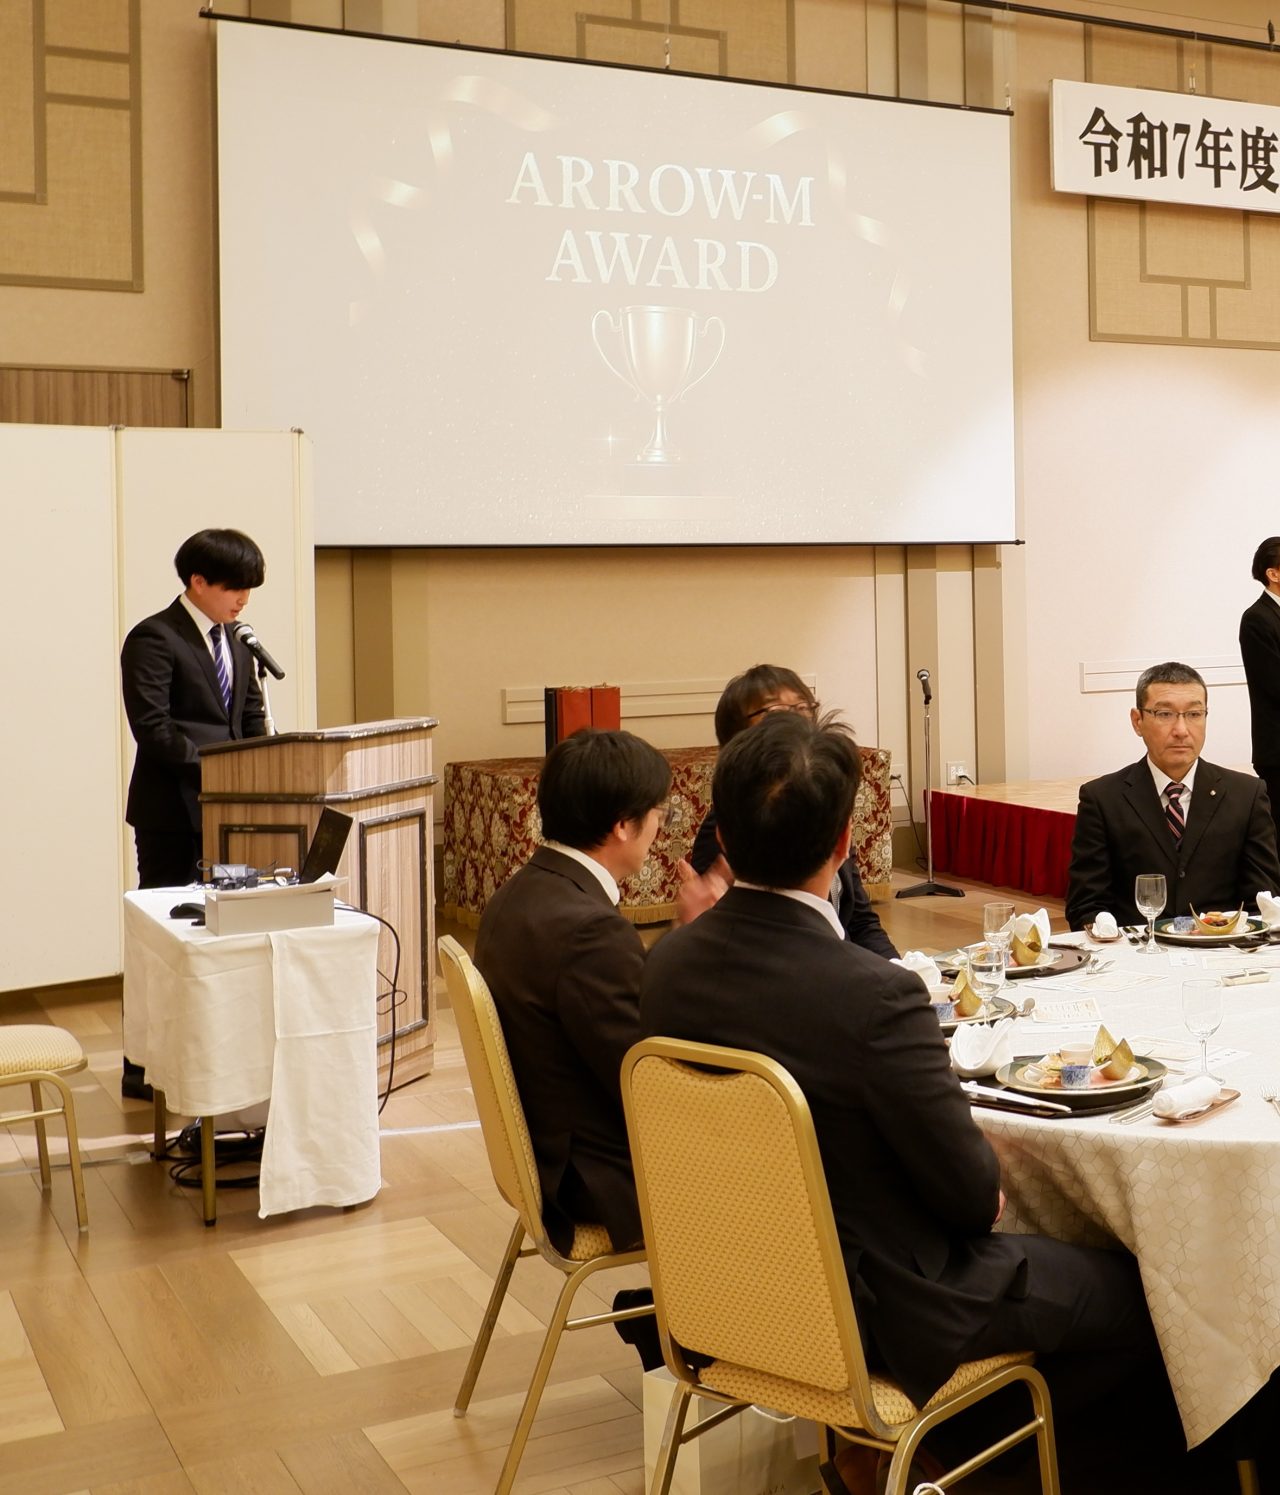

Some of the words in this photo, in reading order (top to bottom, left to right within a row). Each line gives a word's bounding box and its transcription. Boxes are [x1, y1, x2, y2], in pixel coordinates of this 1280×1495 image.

[1079, 107, 1280, 194] 令和7年度
[505, 152, 816, 226] ARROW-M
[545, 229, 779, 293] AWARD
